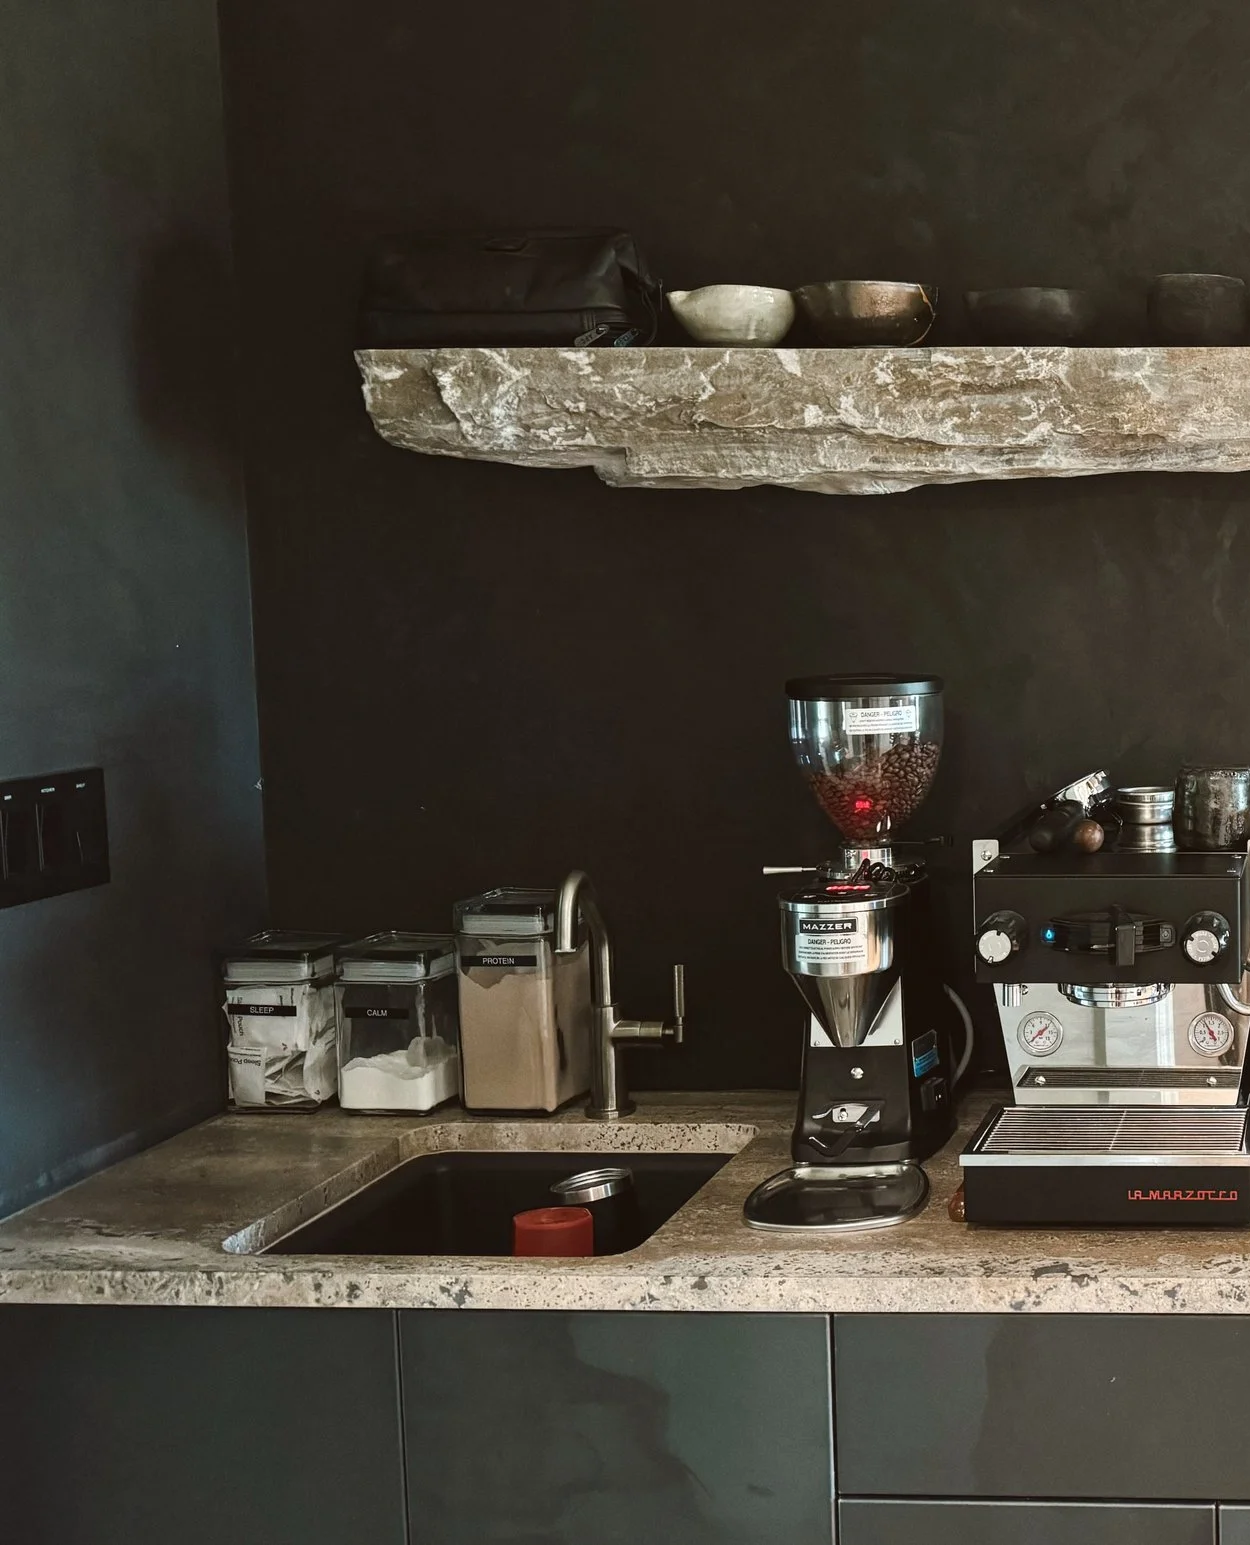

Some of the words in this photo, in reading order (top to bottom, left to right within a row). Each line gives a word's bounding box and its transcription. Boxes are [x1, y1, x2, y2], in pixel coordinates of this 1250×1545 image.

[802, 922, 853, 931] MAZZER
[482, 957, 515, 965] PROTEIN
[249, 1006, 275, 1014] SLEEP
[366, 1009, 388, 1017] CALM
